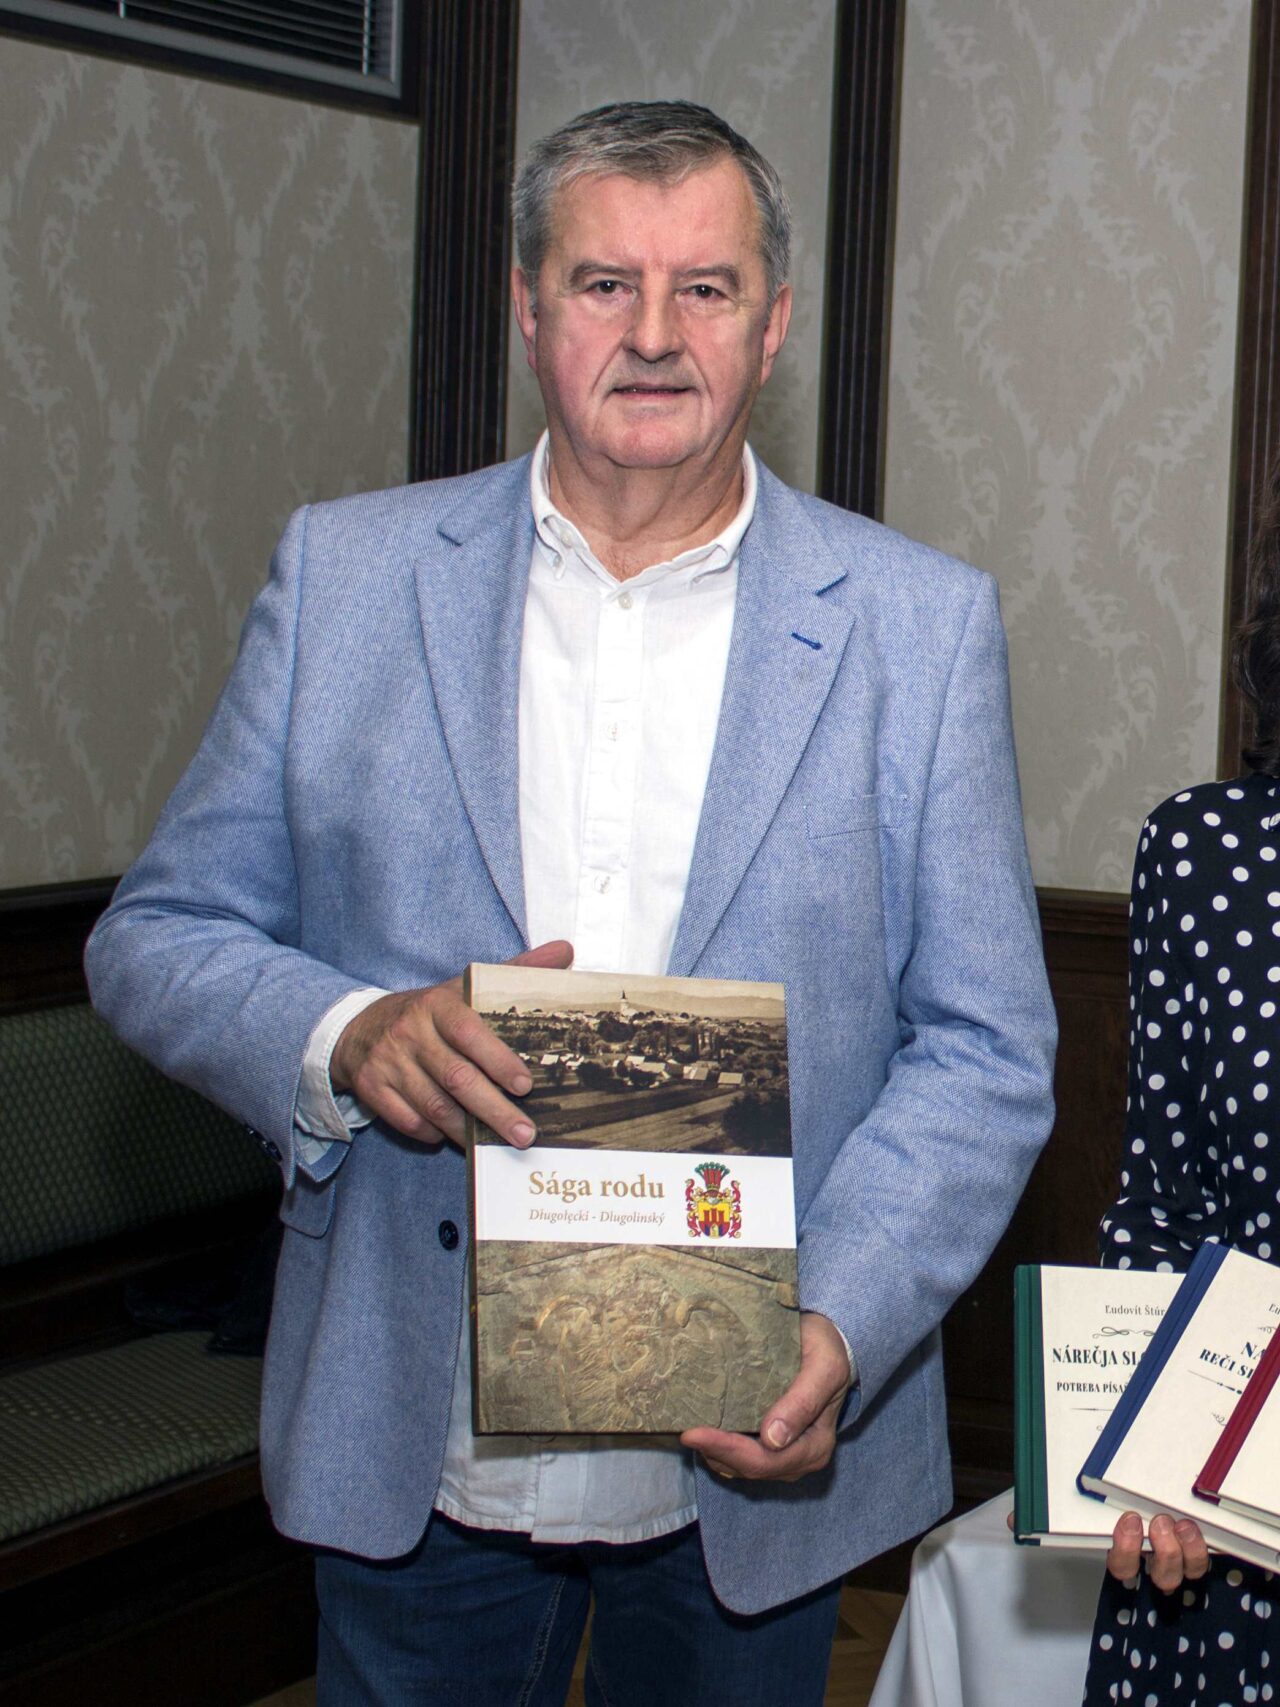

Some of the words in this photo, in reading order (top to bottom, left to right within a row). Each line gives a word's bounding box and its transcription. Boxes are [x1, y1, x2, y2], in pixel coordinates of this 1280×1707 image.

[529, 1170, 593, 1203] Sága
[600, 1173, 665, 1199] rodu
[1105, 1304, 1143, 1315] Ľudovít
[1052, 1344, 1118, 1367] NÁREČJA
[1199, 1348, 1236, 1371] REČI
[1056, 1381, 1101, 1393] POTREBA
